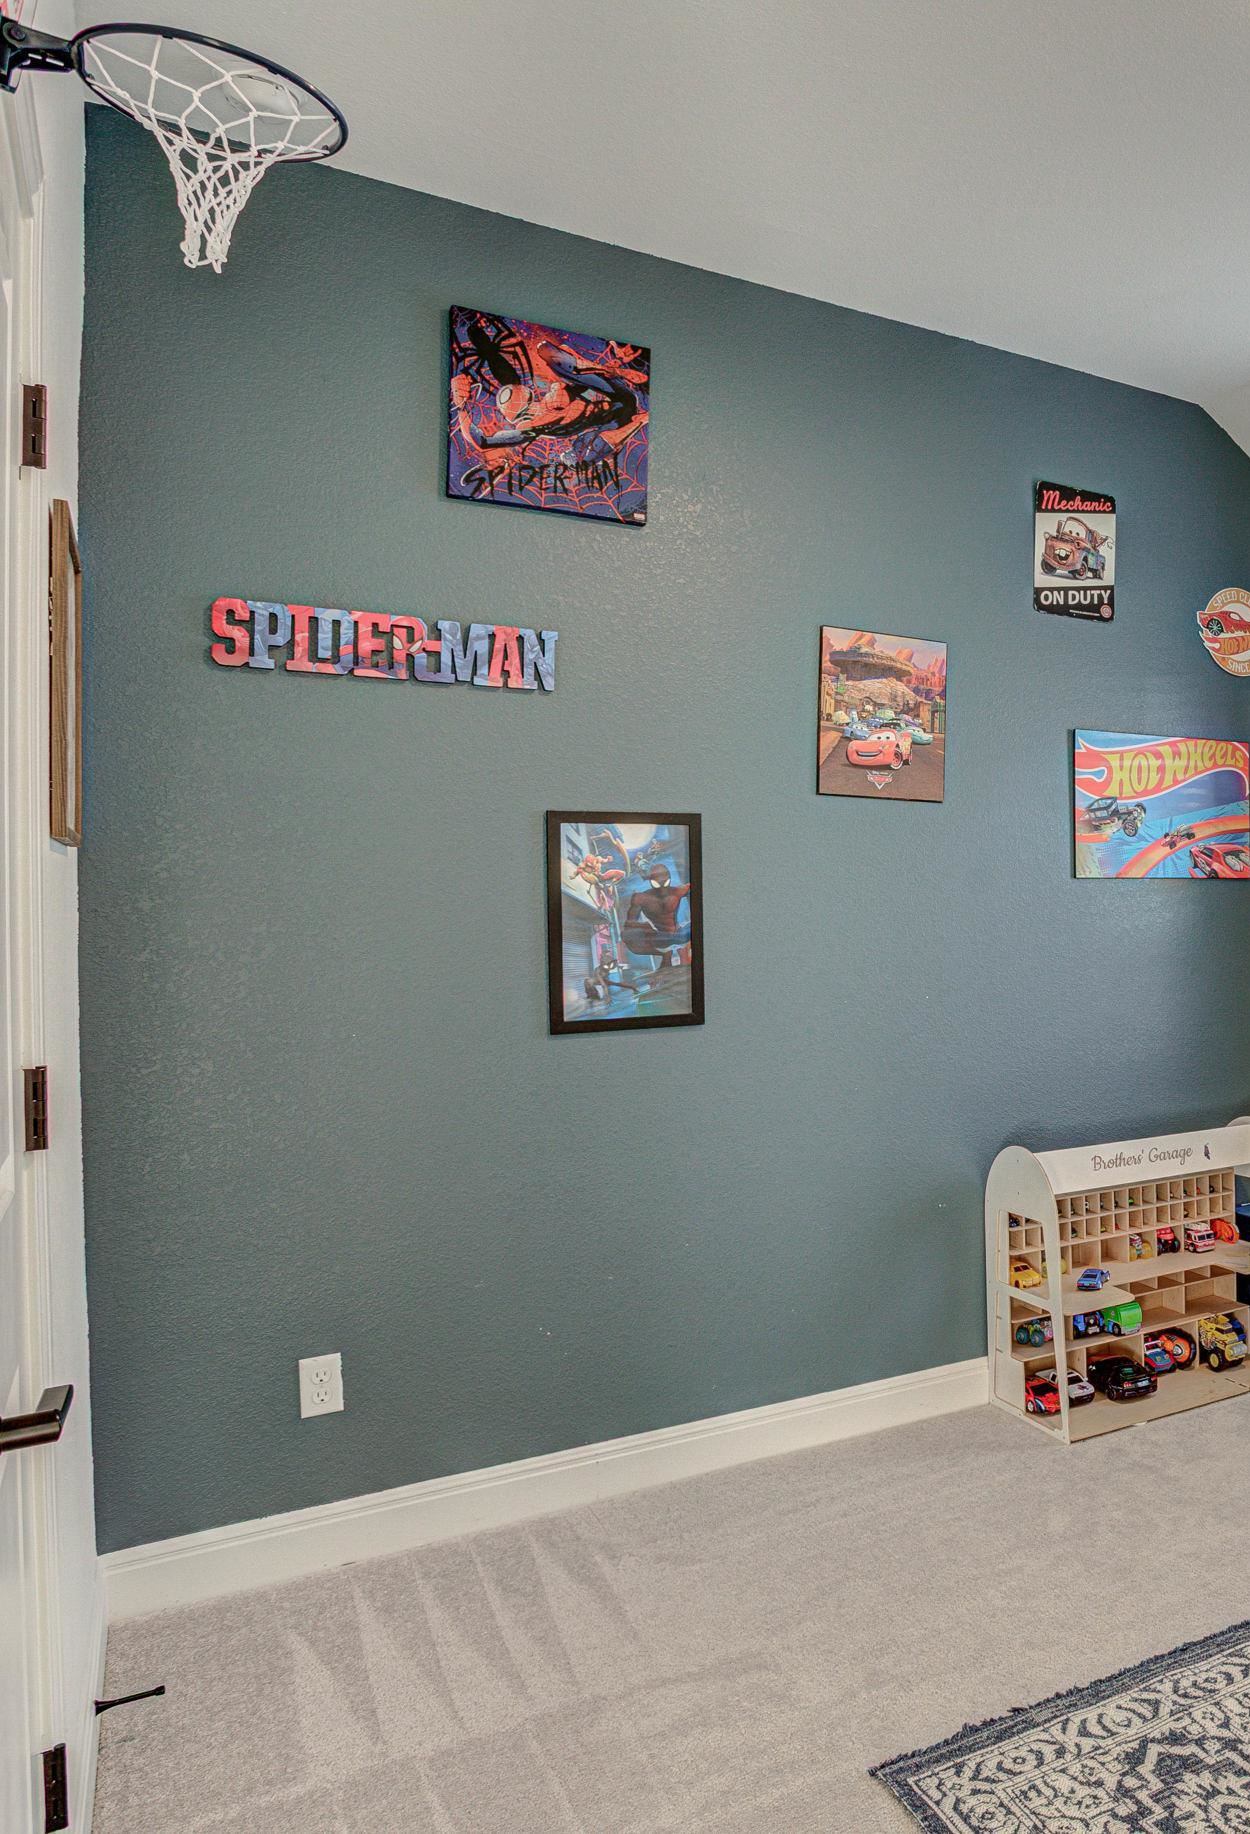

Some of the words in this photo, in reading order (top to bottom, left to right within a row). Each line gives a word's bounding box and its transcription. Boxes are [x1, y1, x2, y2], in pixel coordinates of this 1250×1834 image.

[460, 454, 622, 499] SPIDER-MAN
[1041, 490, 1112, 512] Mechanic
[1040, 590, 1064, 605] ON
[1068, 589, 1111, 605] DUTY
[1213, 591, 1238, 609] SPEED
[211, 597, 559, 691] SPIDER-MAN
[1227, 660, 1250, 673] SINCE
[1091, 1149, 1144, 1171] Brothers'
[1148, 1147, 1194, 1165] Garage
